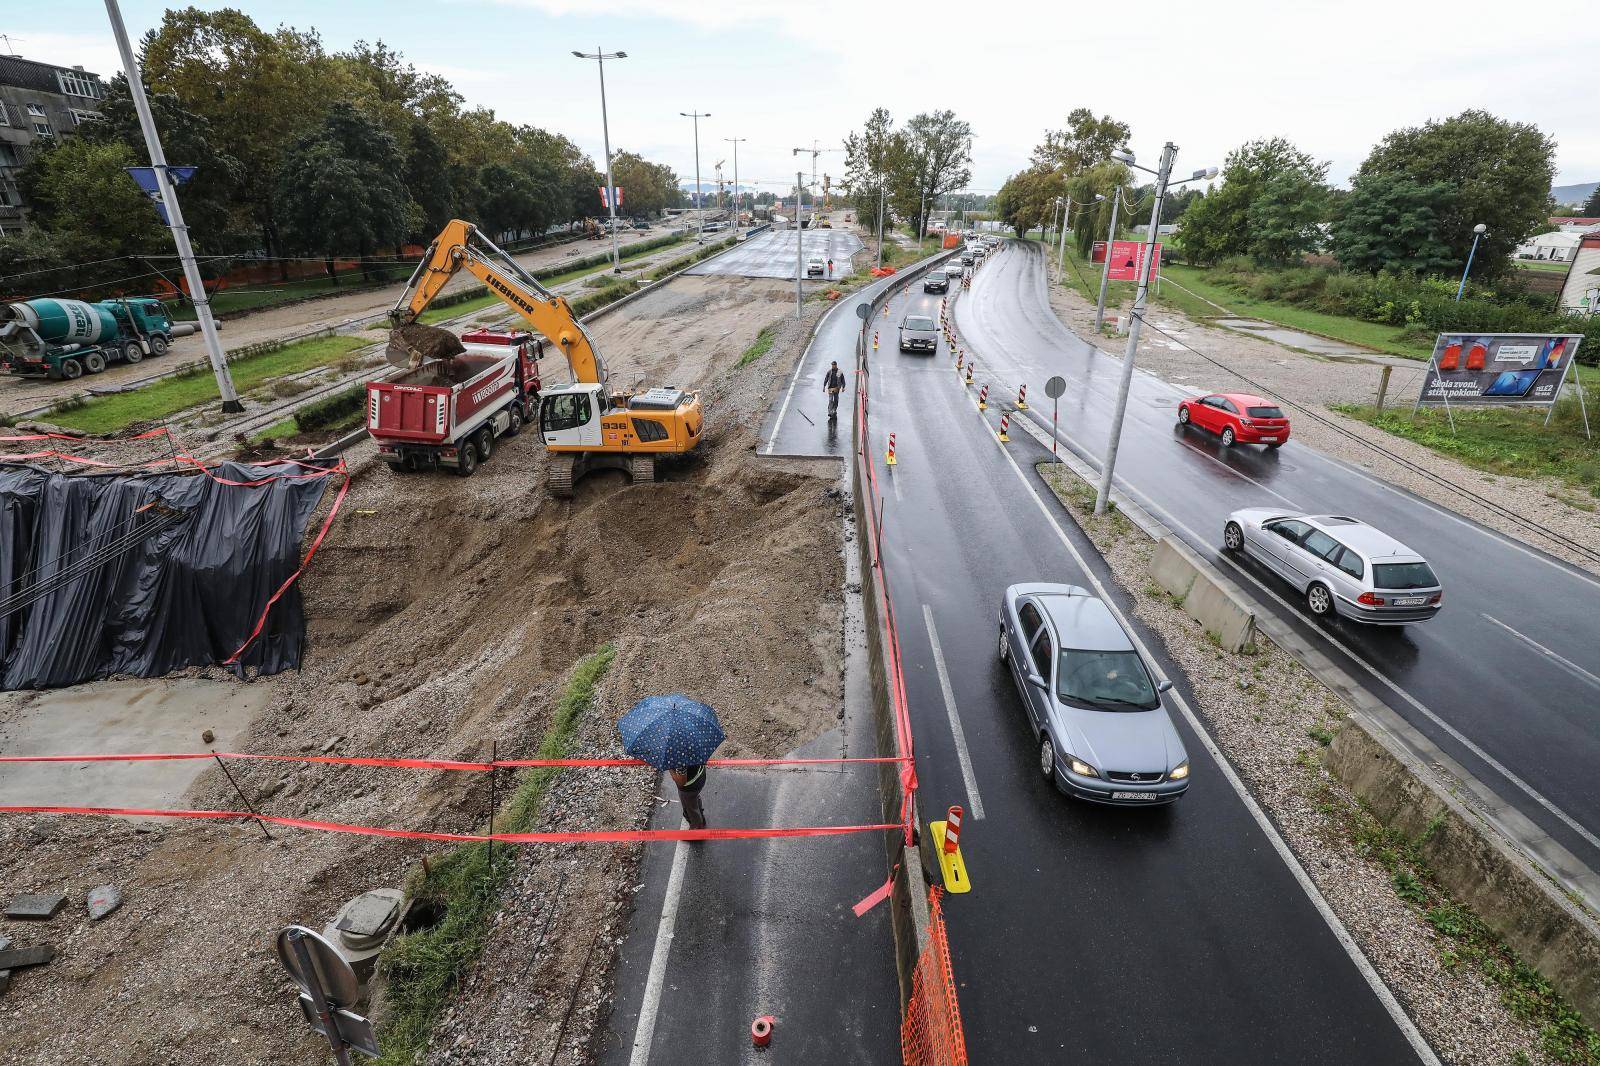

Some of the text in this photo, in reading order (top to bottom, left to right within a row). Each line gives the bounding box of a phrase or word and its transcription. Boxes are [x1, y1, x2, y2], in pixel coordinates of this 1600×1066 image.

[485, 274, 534, 315] LIEBHERR
[1454, 380, 1478, 389] zvoni,
[602, 422, 627, 430] 936
